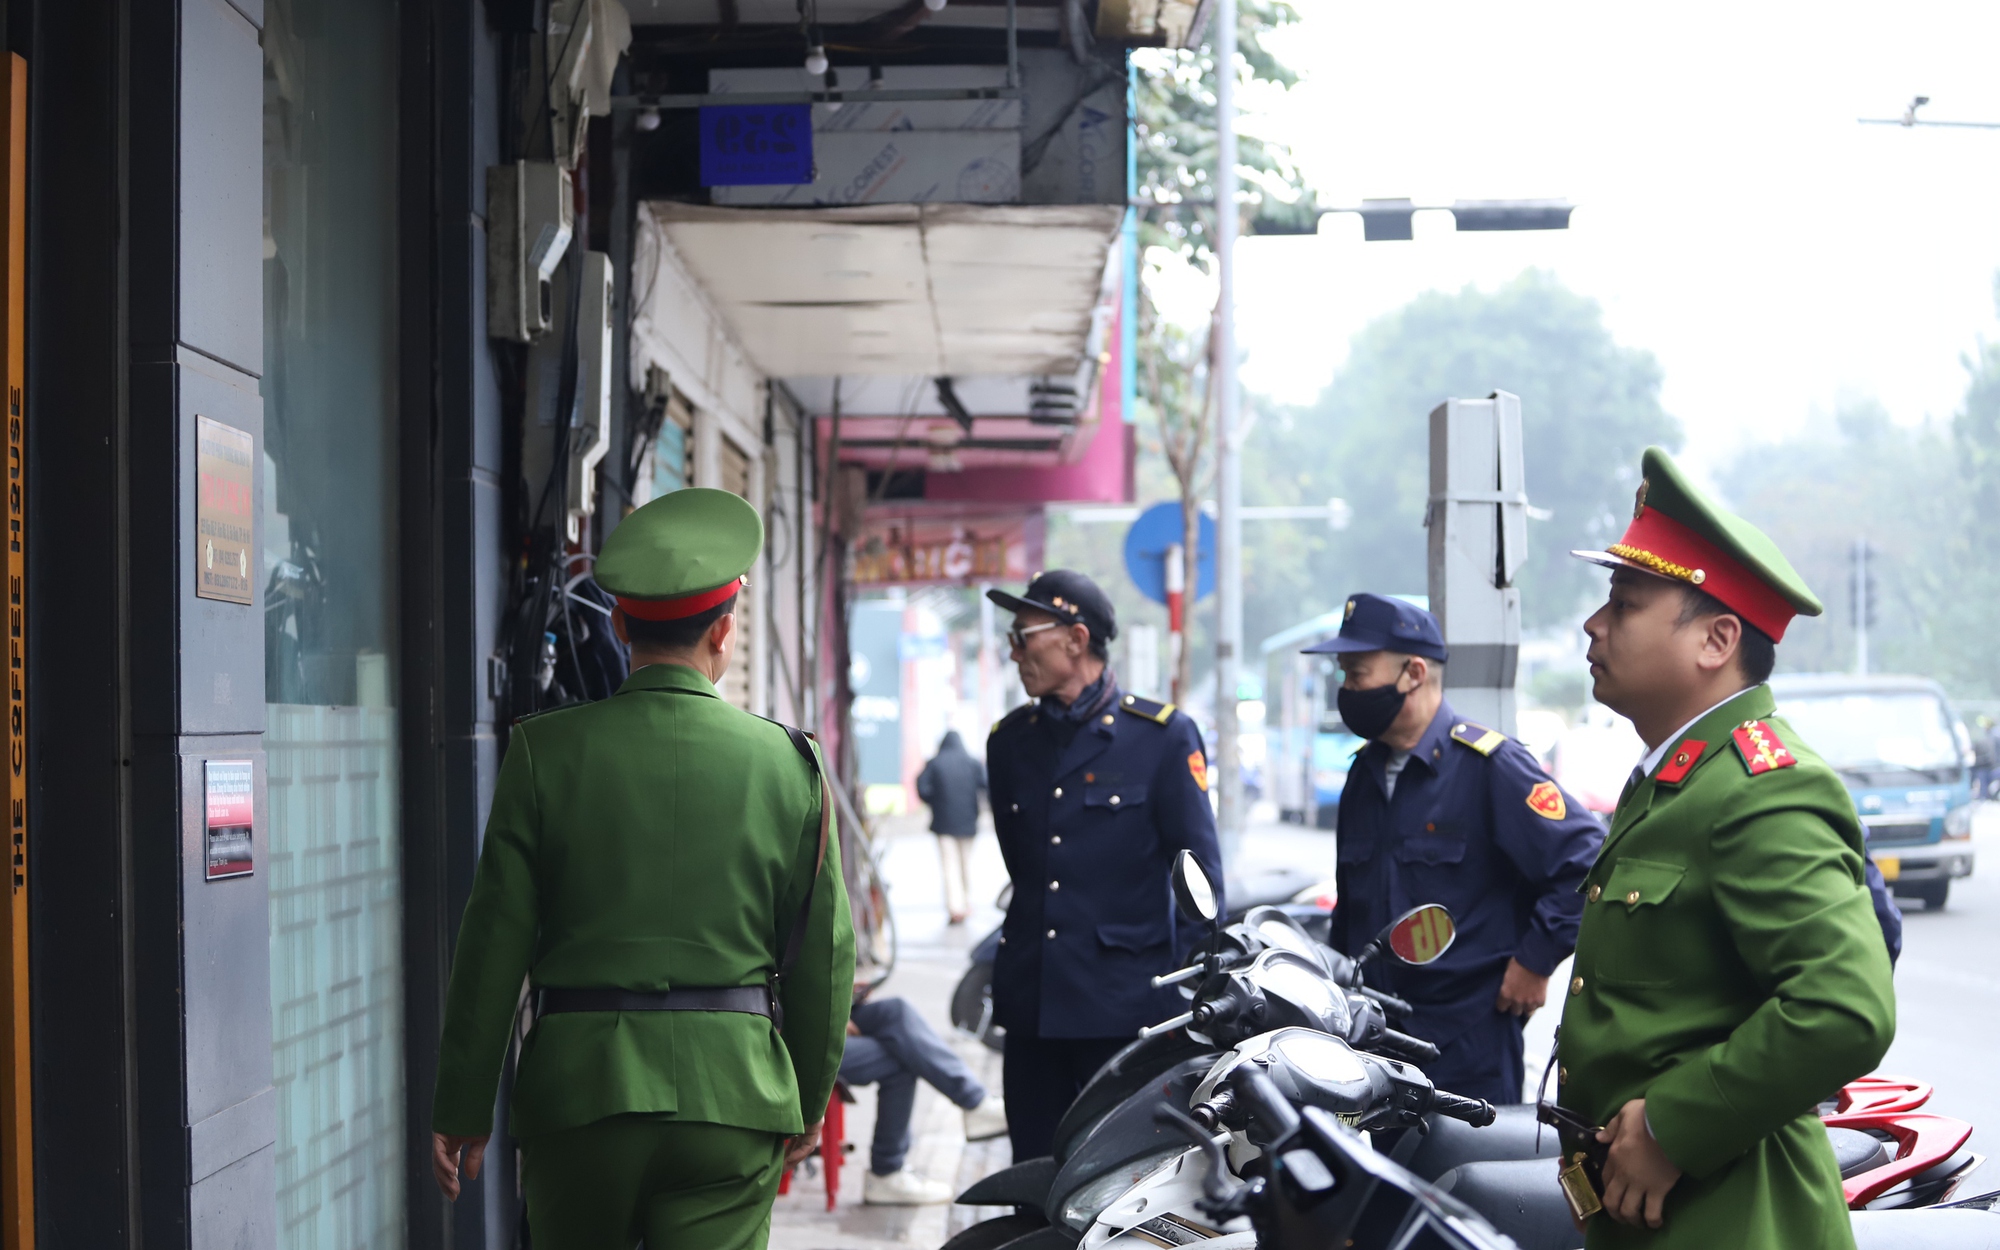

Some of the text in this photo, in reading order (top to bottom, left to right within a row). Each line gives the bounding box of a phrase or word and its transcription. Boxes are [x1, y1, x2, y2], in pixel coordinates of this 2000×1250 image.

[9, 385, 23, 895] THE COFFEE HOUSE
